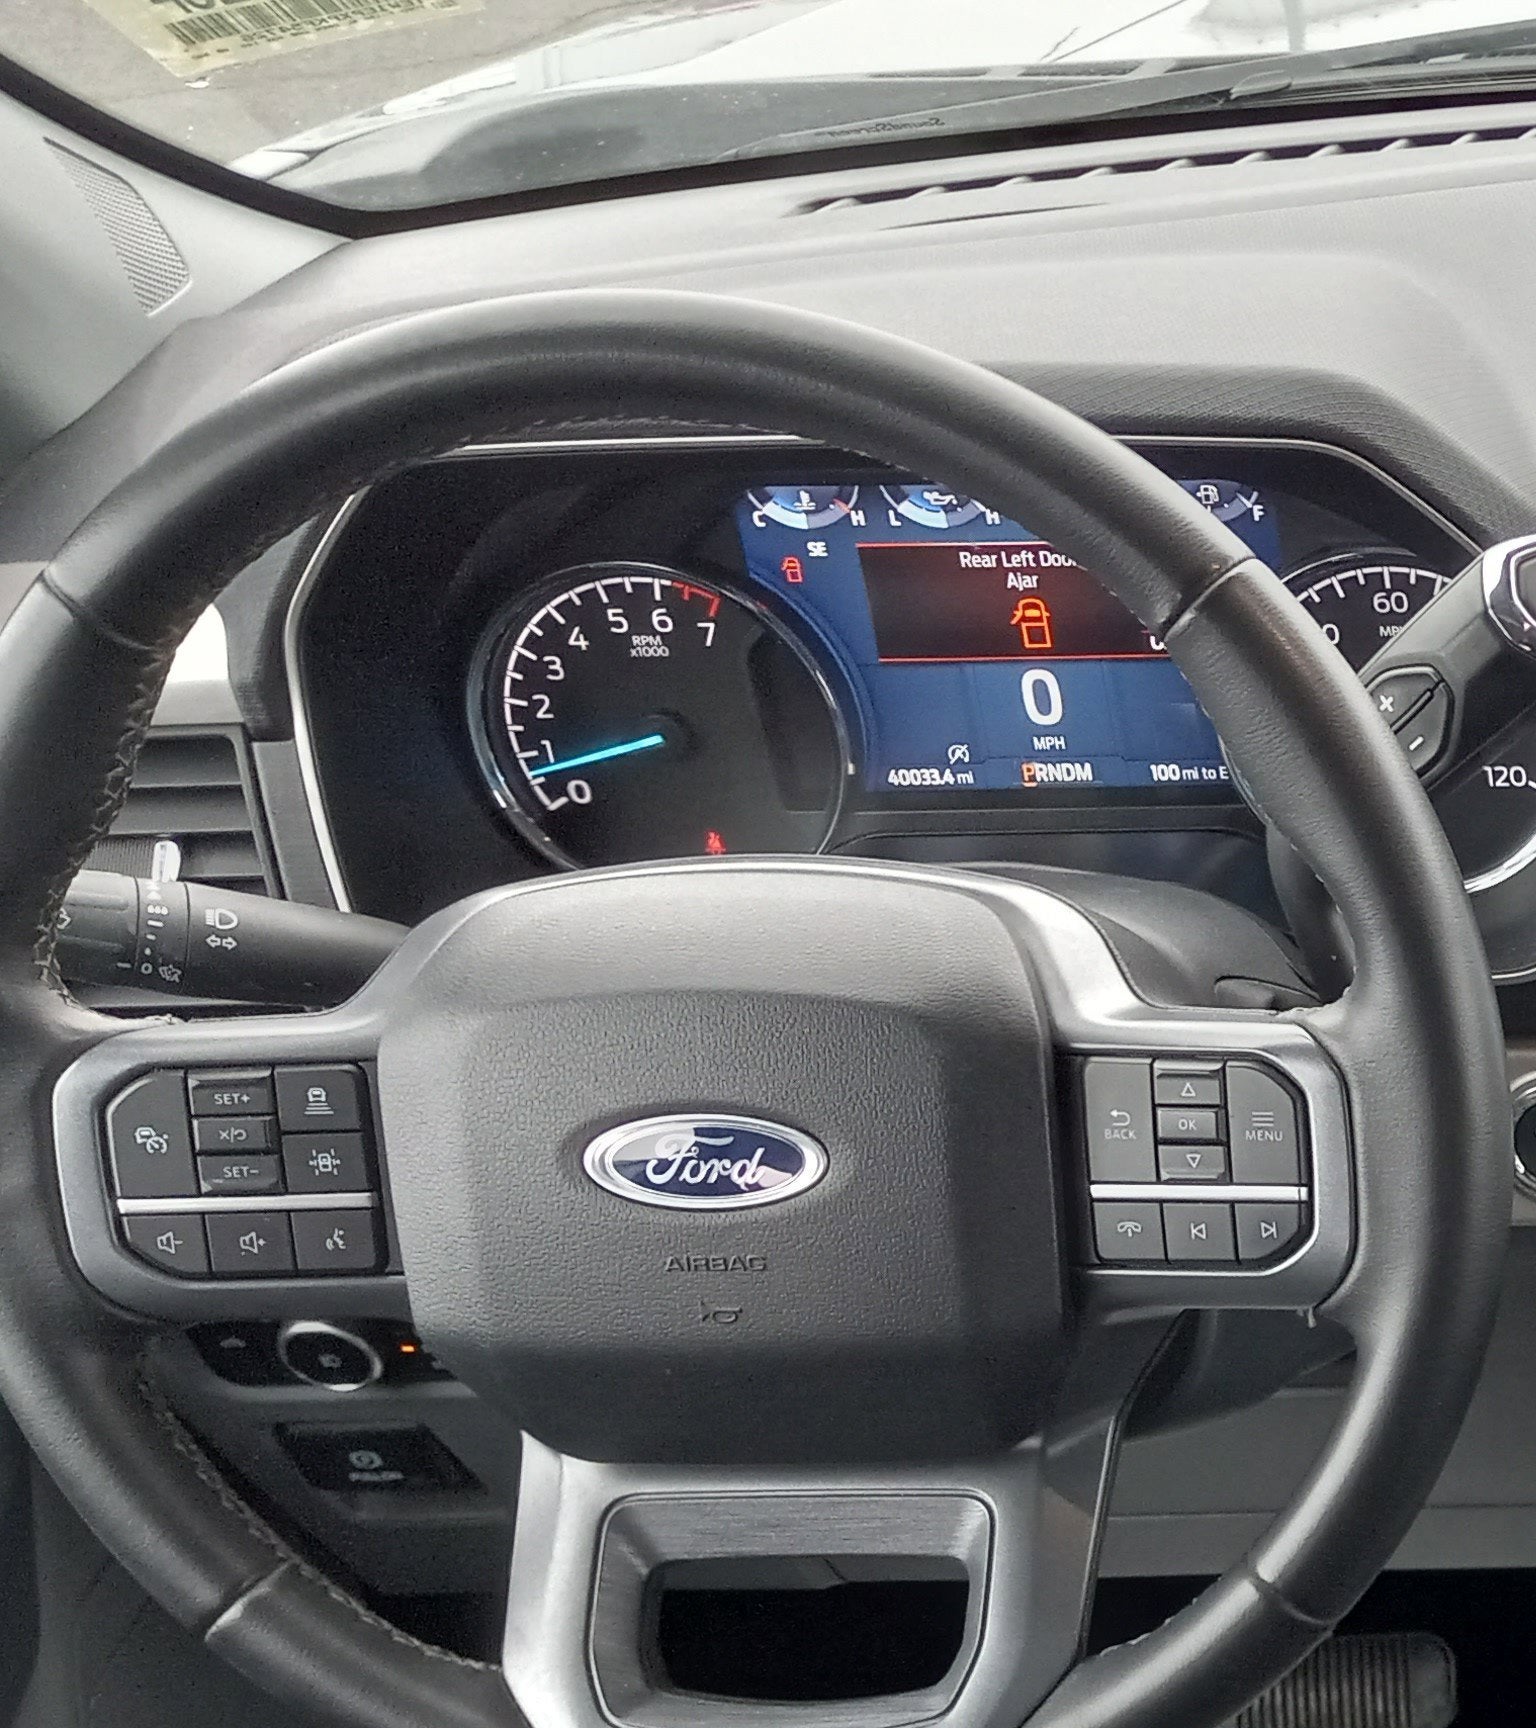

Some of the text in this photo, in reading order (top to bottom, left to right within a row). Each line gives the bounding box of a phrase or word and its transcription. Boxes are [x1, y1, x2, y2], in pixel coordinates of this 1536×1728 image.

[752, 510, 767, 528] C
[850, 509, 867, 527] H
[888, 509, 902, 527] L
[1252, 504, 1265, 522] F
[806, 541, 828, 557] SE
[959, 550, 1078, 568] Rear Left Doo
[1006, 571, 1039, 591] Ajar
[1372, 591, 1409, 614] 60
[607, 608, 629, 633] 5
[652, 608, 673, 633] 6
[568, 625, 590, 650] 4
[631, 635, 662, 647] RPM
[697, 622, 716, 647] 7
[630, 646, 669, 658] x1000
[543, 656, 565, 681] 3
[1020, 668, 1065, 727] 0
[532, 695, 554, 720] 2
[539, 740, 555, 763] 1
[1032, 736, 1067, 751] MPH
[887, 768, 975, 786] 40033.4 mi
[1149, 763, 1181, 782] 100
[1182, 767, 1200, 782] mi
[1201, 766, 1217, 781] to
[1482, 764, 1527, 788] 120
[566, 779, 593, 805] 0
[1104, 1128, 1137, 1140] BACK
[1178, 1118, 1197, 1131] OK
[1245, 1129, 1284, 1142] MENU
[645, 1132, 767, 1192] Ford
[664, 1254, 769, 1273] AIRBAG
